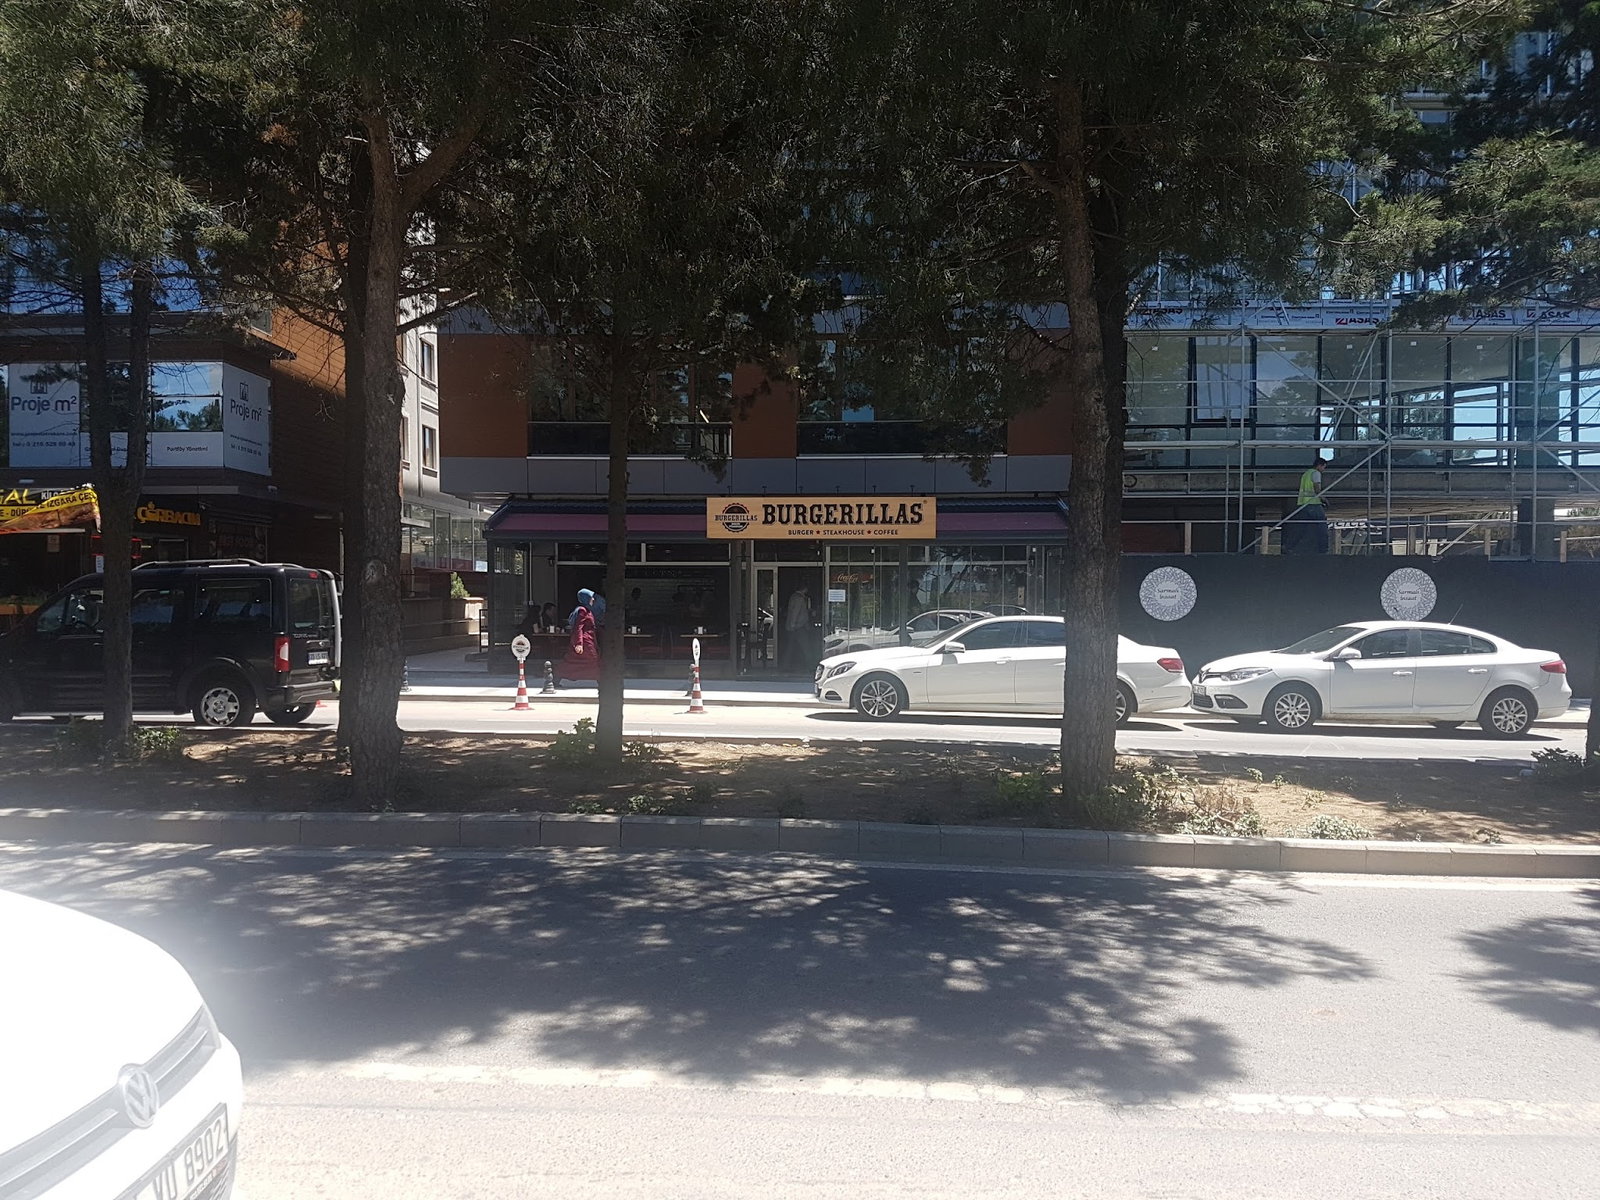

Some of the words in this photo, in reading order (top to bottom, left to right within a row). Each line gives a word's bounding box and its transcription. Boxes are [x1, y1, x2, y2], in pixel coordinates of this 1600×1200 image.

[11, 396, 50, 415] Proje
[230, 398, 250, 421] Proje
[762, 503, 923, 525] BURGERILLAS
[184, 1118, 224, 1187] 8902
